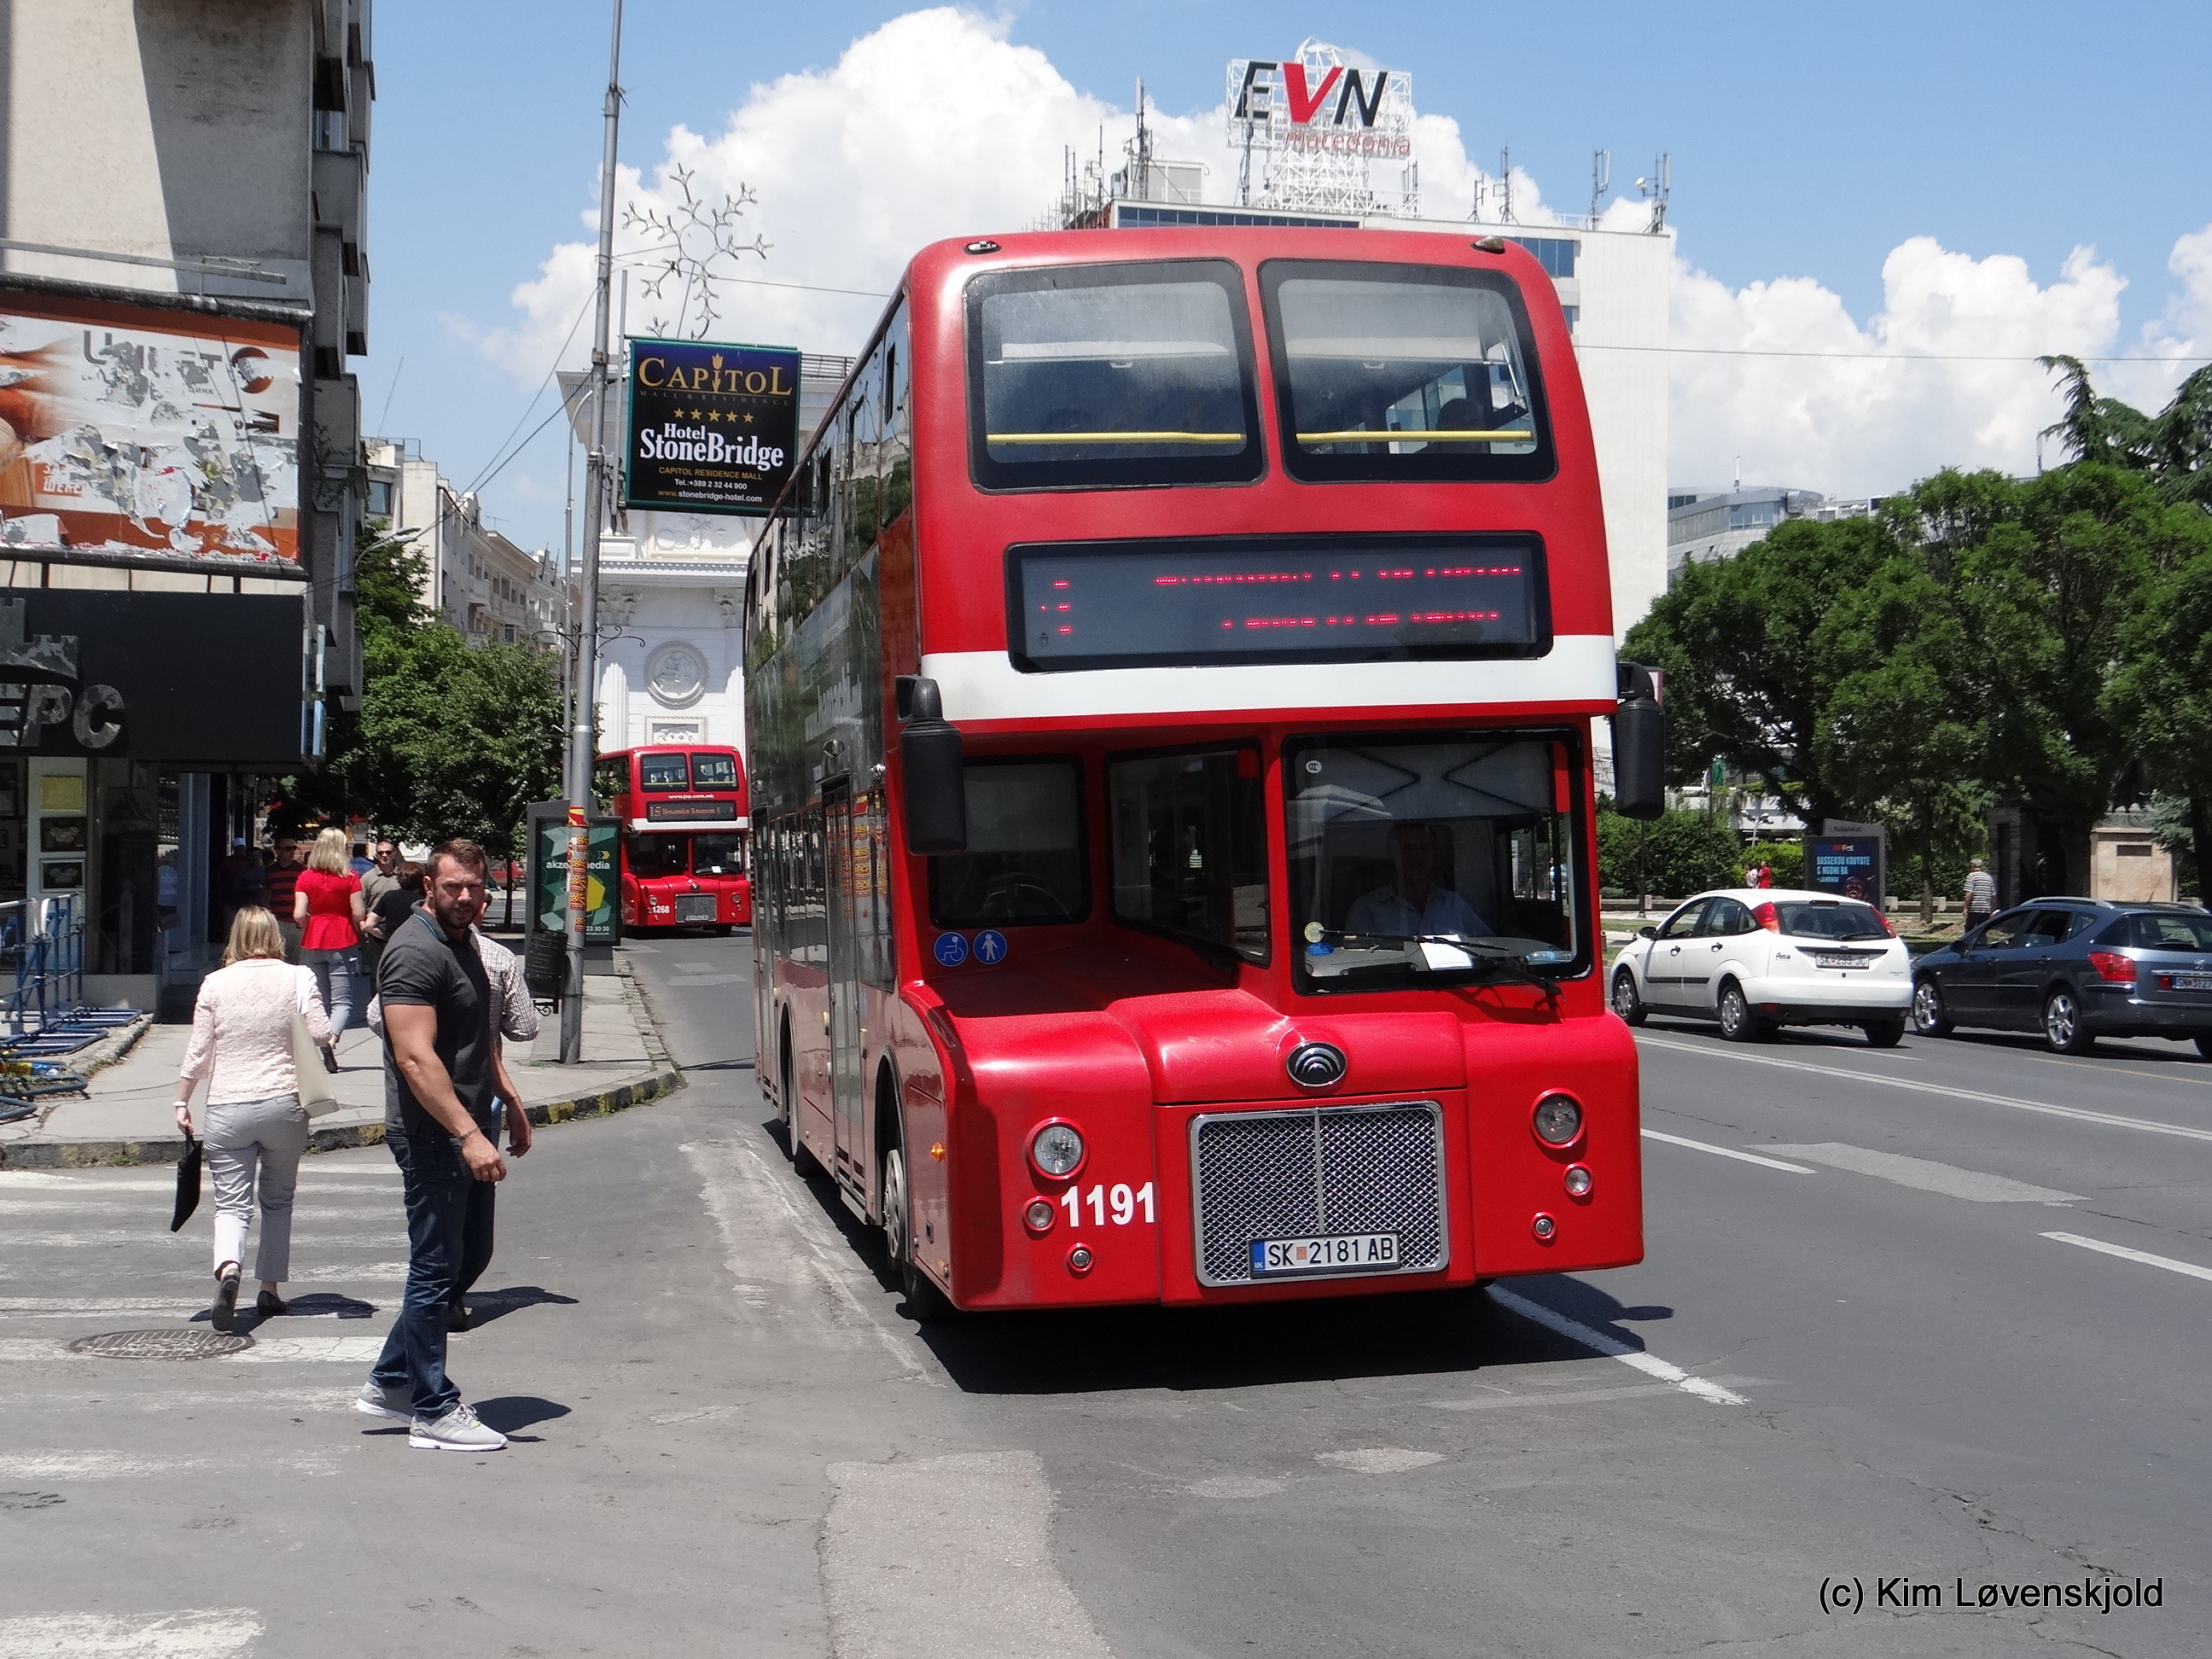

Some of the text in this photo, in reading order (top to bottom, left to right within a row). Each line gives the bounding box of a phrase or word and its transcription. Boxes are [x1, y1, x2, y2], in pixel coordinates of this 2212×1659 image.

[1232, 61, 1388, 128] EVN
[1284, 130, 1411, 155] macedonia
[638, 355, 793, 396] CAPITOL
[664, 422, 706, 440] Hotel
[640, 428, 784, 471] StoneBridge
[658, 466, 763, 480] CAPITOL RESIDENCE MALL
[652, 905, 670, 914] 1268
[1819, 955, 1831, 965] SK
[1061, 1182, 1155, 1227] 1191
[1268, 1237, 1394, 1266] SK 2181 AB
